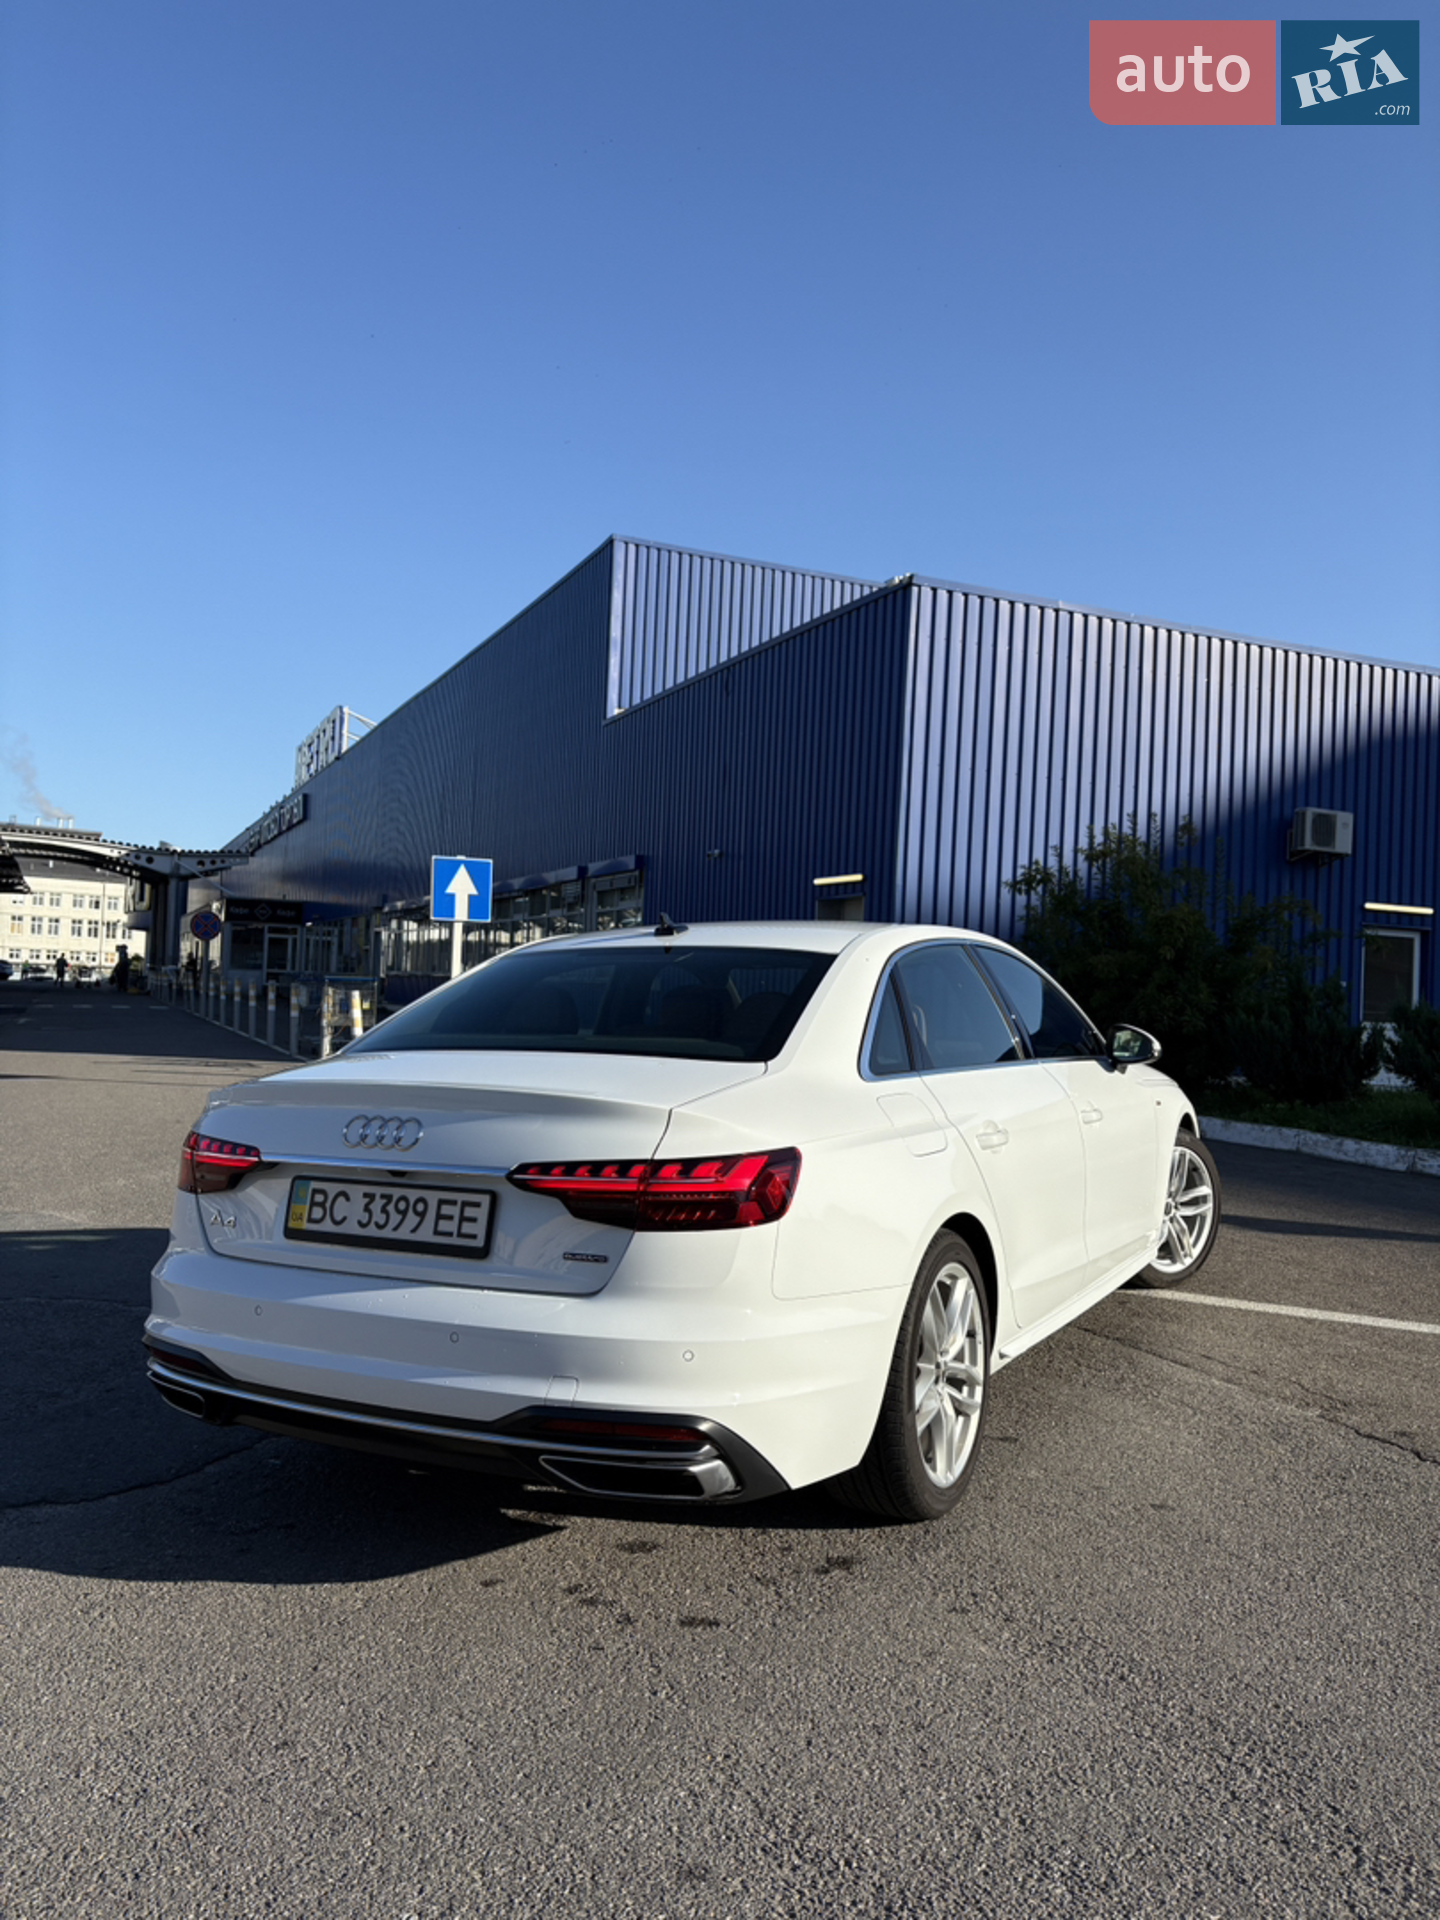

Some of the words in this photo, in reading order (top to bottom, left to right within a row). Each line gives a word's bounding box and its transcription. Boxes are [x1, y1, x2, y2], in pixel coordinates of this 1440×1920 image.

[210, 1209, 237, 1229] A4
[307, 1187, 350, 1226] BC
[357, 1192, 429, 1233] 3399
[433, 1198, 482, 1239] EE
